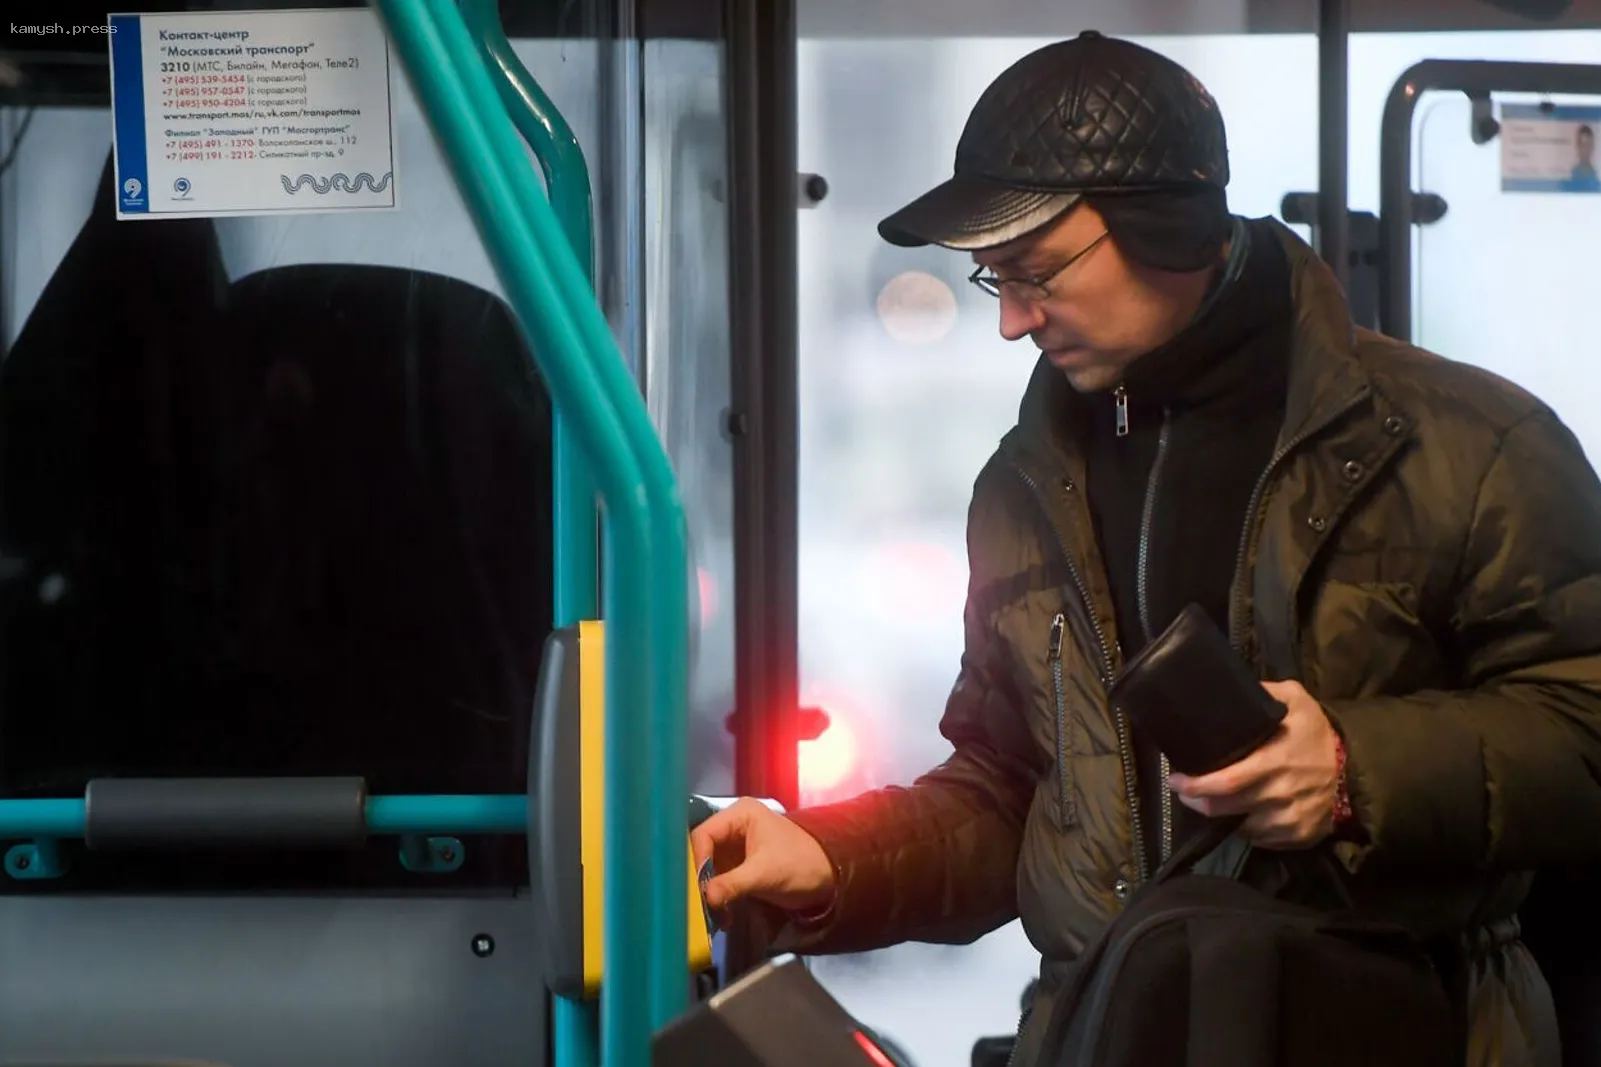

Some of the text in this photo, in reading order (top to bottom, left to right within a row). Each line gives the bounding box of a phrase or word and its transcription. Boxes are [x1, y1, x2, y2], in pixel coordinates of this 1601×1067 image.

[159, 30, 249, 42] Контакт-центр
[160, 57, 360, 73] 3210 (МТС, Билайн, Мегафон, Теле2)
[162, 76, 173, 85] +7
[175, 75, 199, 86] (495)
[257, 73, 307, 84] городского)
[162, 88, 173, 96] +7
[176, 87, 200, 97] (495)
[201, 86, 246, 96] 957-0547
[257, 84, 307, 96] городского)
[163, 100, 174, 108] +7
[176, 99, 200, 109] (495)
[202, 98, 247, 108] 950-4204
[258, 96, 308, 107] городского)
[164, 129, 201, 138] Филиал
[262, 125, 280, 135] ГУП
[165, 141, 176, 149] +7
[179, 140, 203, 150] (495)
[205, 139, 221, 148] 491
[341, 136, 358, 145] 112
[166, 152, 177, 161] +7
[179, 151, 204, 162] (499)
[206, 151, 222, 160] 191
